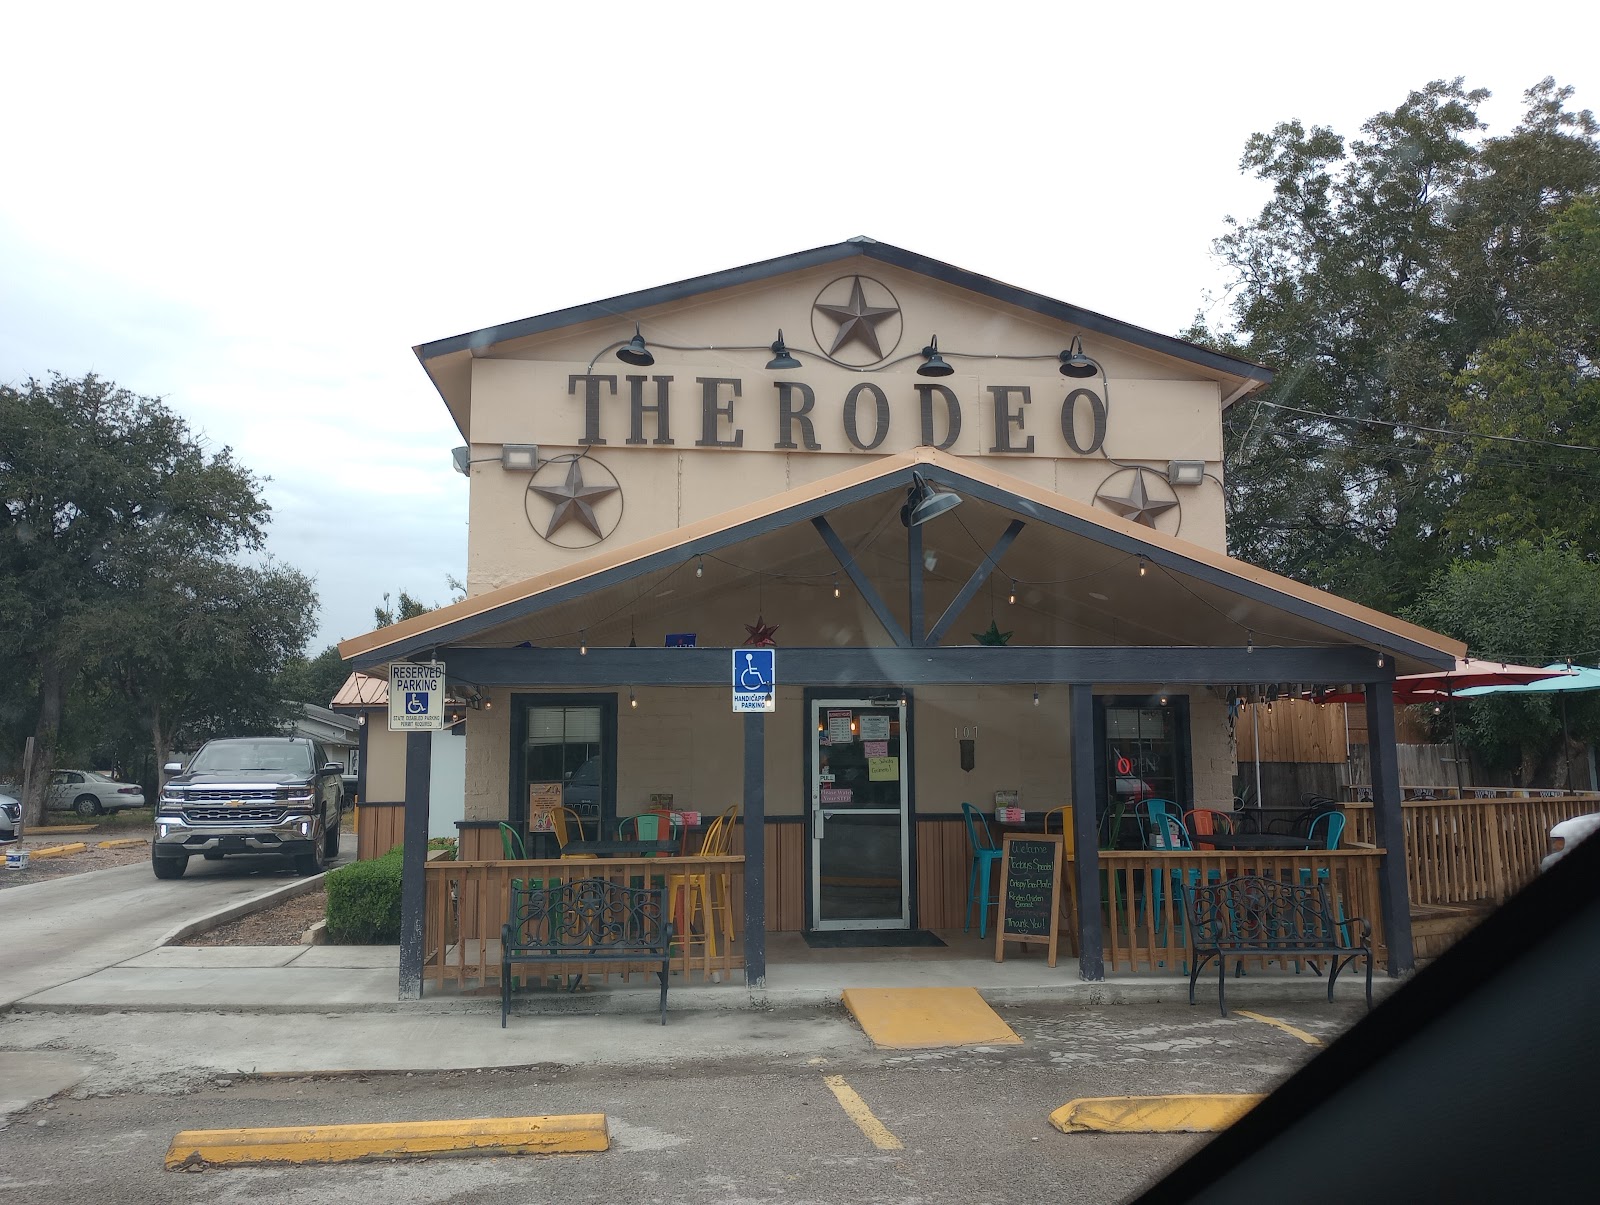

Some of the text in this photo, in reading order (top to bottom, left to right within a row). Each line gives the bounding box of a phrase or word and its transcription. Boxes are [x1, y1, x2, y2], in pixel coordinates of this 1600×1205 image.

[568, 375, 1107, 455] THE RODEO
[394, 667, 441, 678] RESERVED
[397, 680, 437, 691] PARKING
[954, 726, 978, 739] 101
[1117, 755, 1155, 774] OPEN
